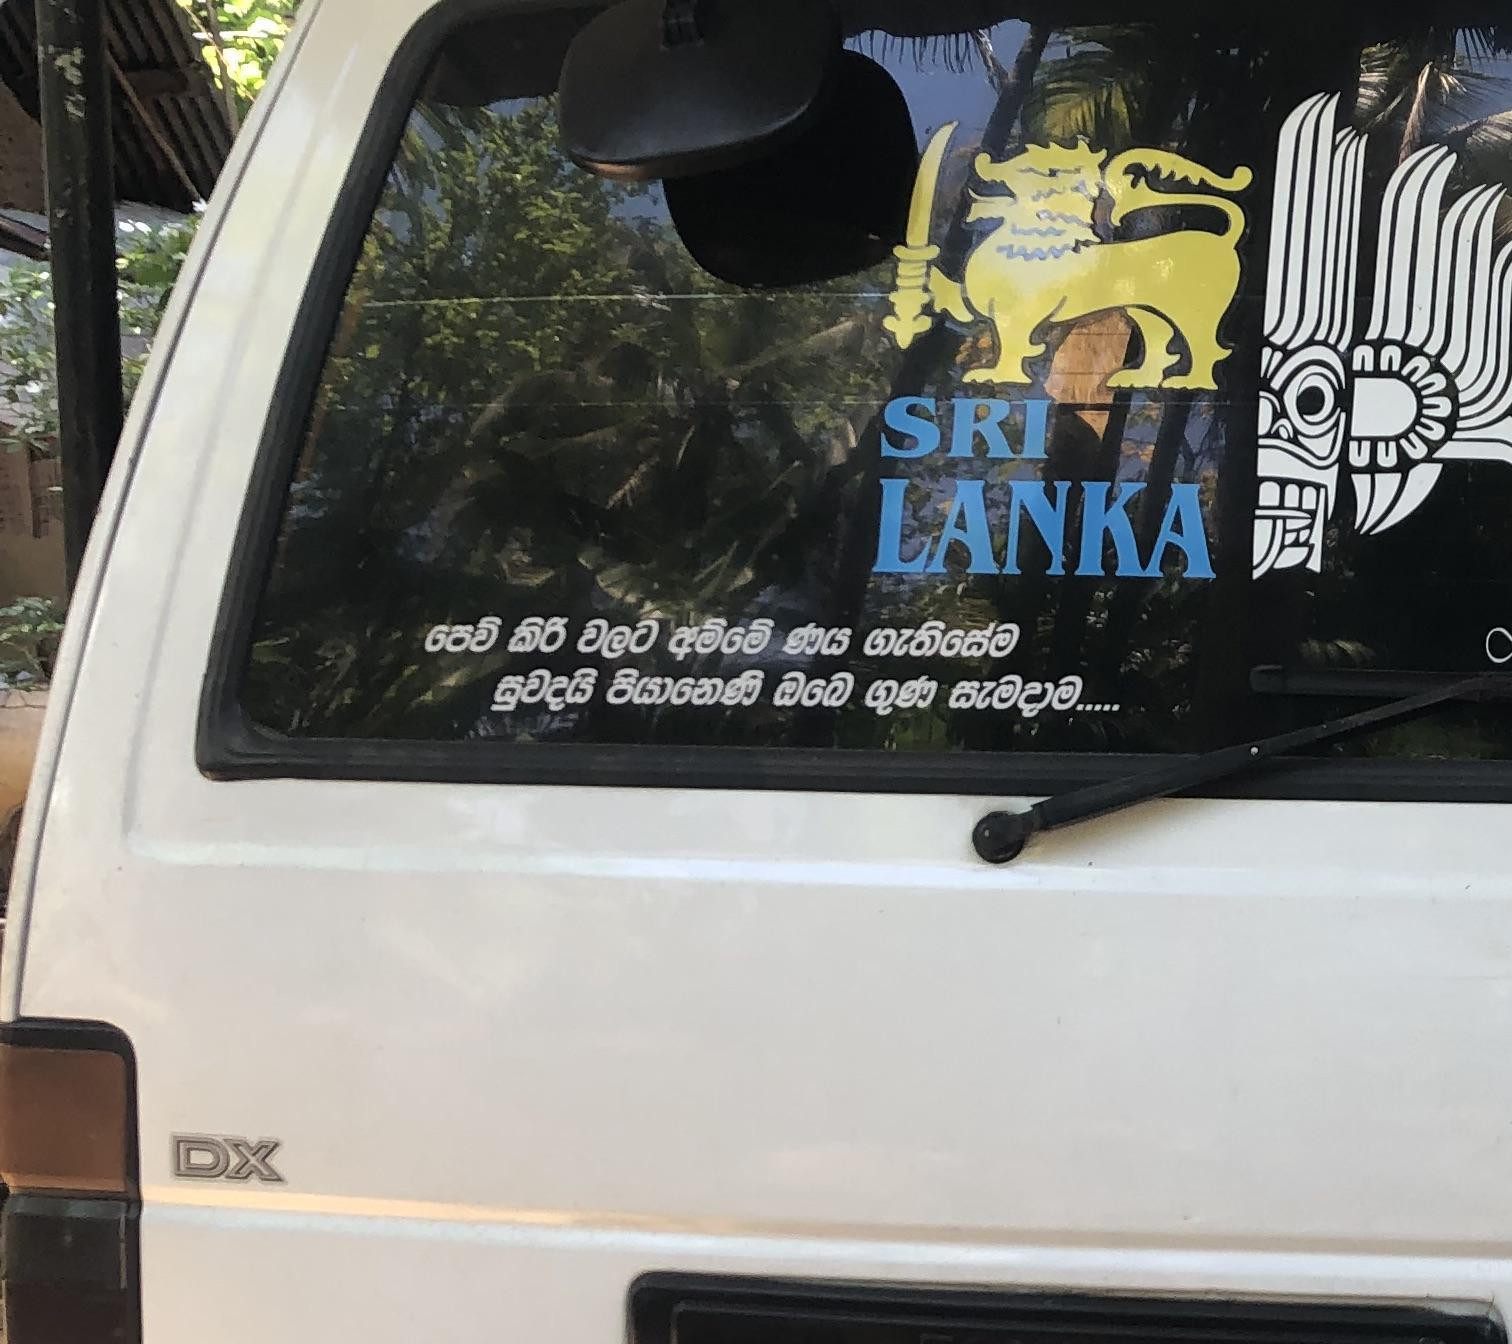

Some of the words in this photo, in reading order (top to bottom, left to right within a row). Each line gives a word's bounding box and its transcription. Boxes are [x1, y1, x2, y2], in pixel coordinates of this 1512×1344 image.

[881, 396, 1048, 459] SRI
[872, 479, 1216, 578] LANKA
[507, 617, 569, 654] කිරි
[577, 619, 659, 659] වලට
[668, 617, 775, 660] අම්මේ
[782, 622, 852, 656] ණය
[863, 675, 939, 716] ගුණ
[172, 1135, 285, 1182] DX
